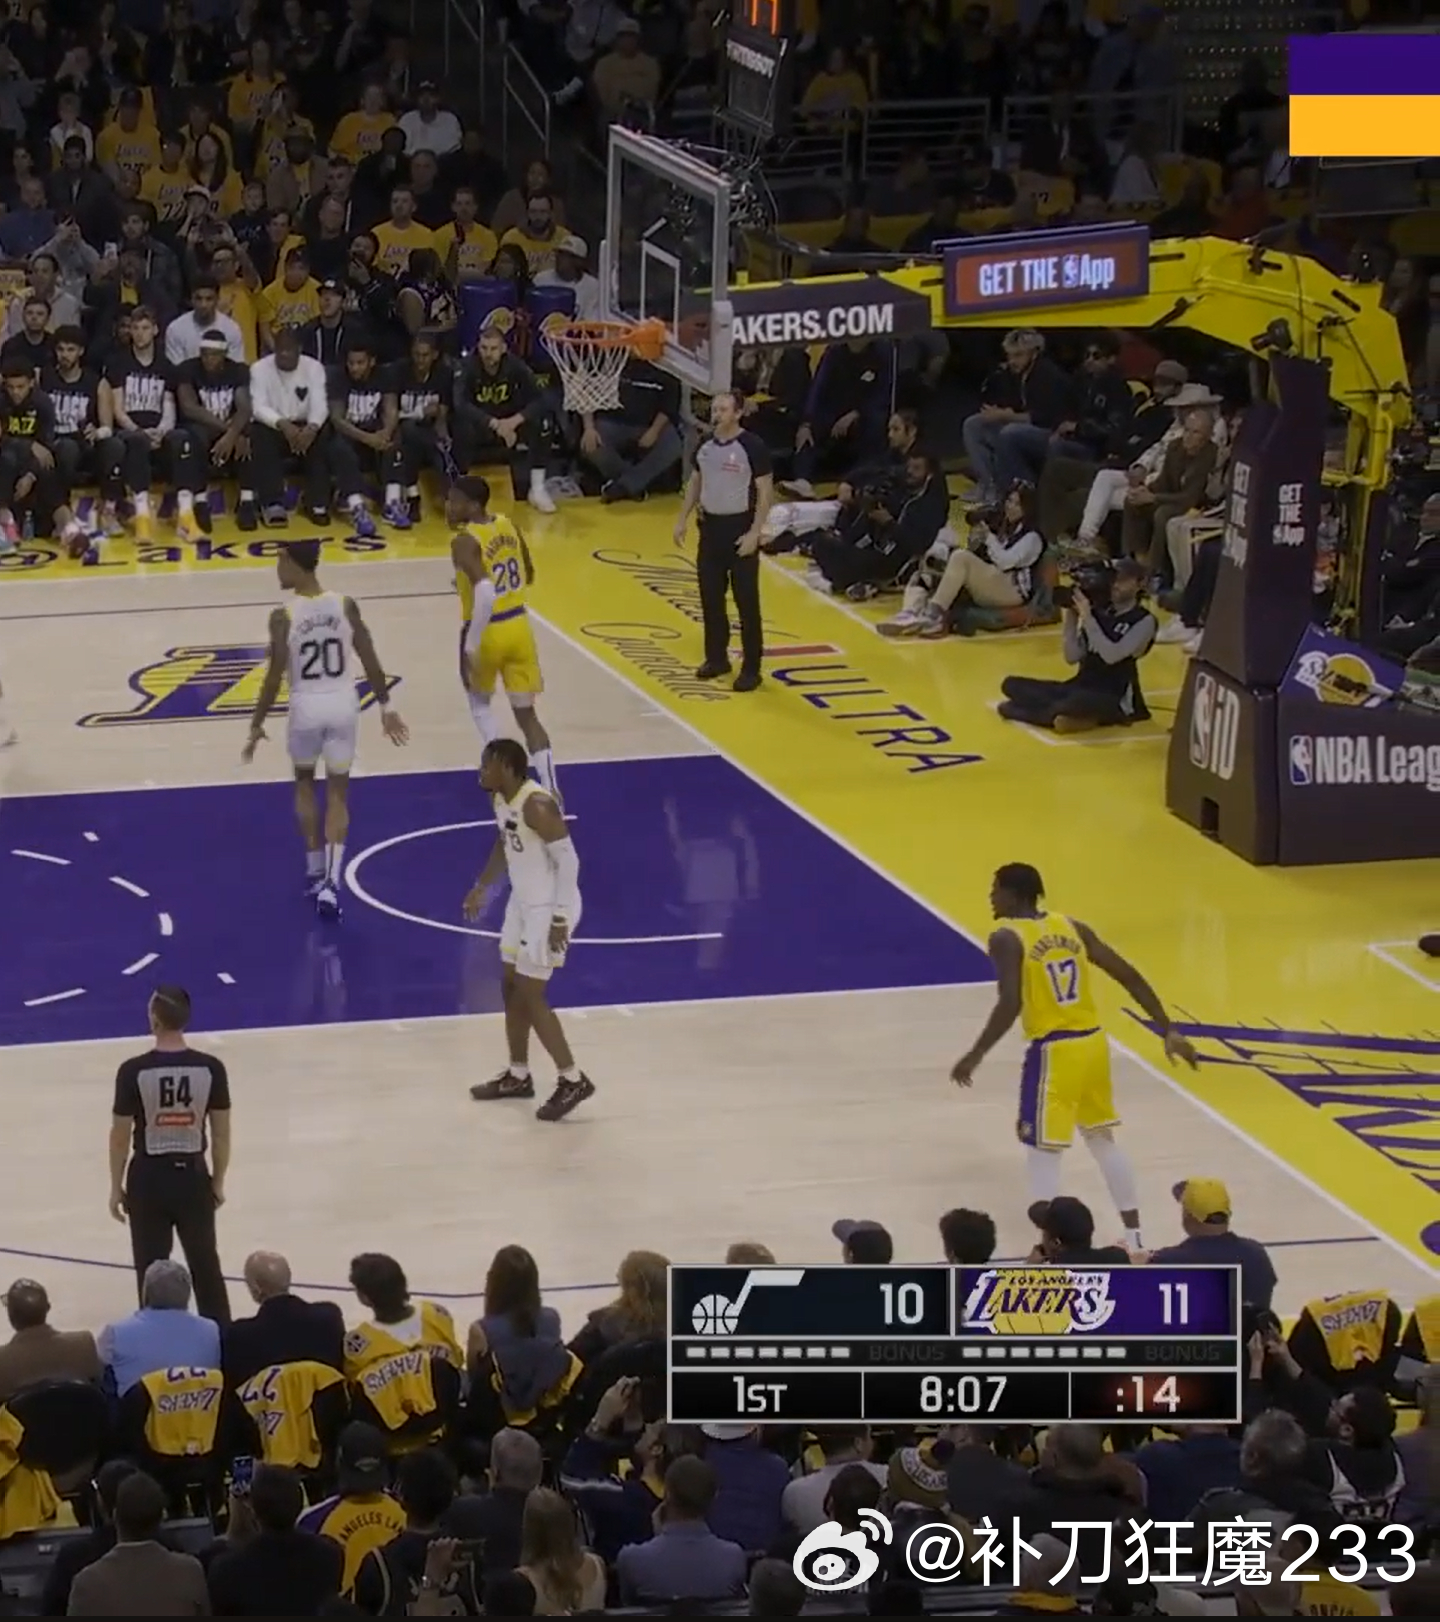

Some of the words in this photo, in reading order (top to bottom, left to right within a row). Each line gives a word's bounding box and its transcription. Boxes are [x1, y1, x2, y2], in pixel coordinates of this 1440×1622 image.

[979, 260, 1015, 297] GET
[1021, 257, 1058, 290] THE
[1078, 254, 1115, 289] App
[732, 303, 894, 345] AKERS.COM
[1278, 483, 1304, 504] GET
[1278, 504, 1303, 523] THE
[1283, 526, 1306, 547] App
[492, 558, 520, 593] 28
[301, 637, 344, 680] 20
[771, 664, 985, 773] ULTRA
[1315, 736, 1374, 784] NBA
[1376, 736, 1440, 792] Leag
[1047, 959, 1077, 1002] 17
[159, 1075, 193, 1108] 64
[365, 1352, 424, 1396] LAKERS
[158, 1387, 216, 1414] LAKERS
